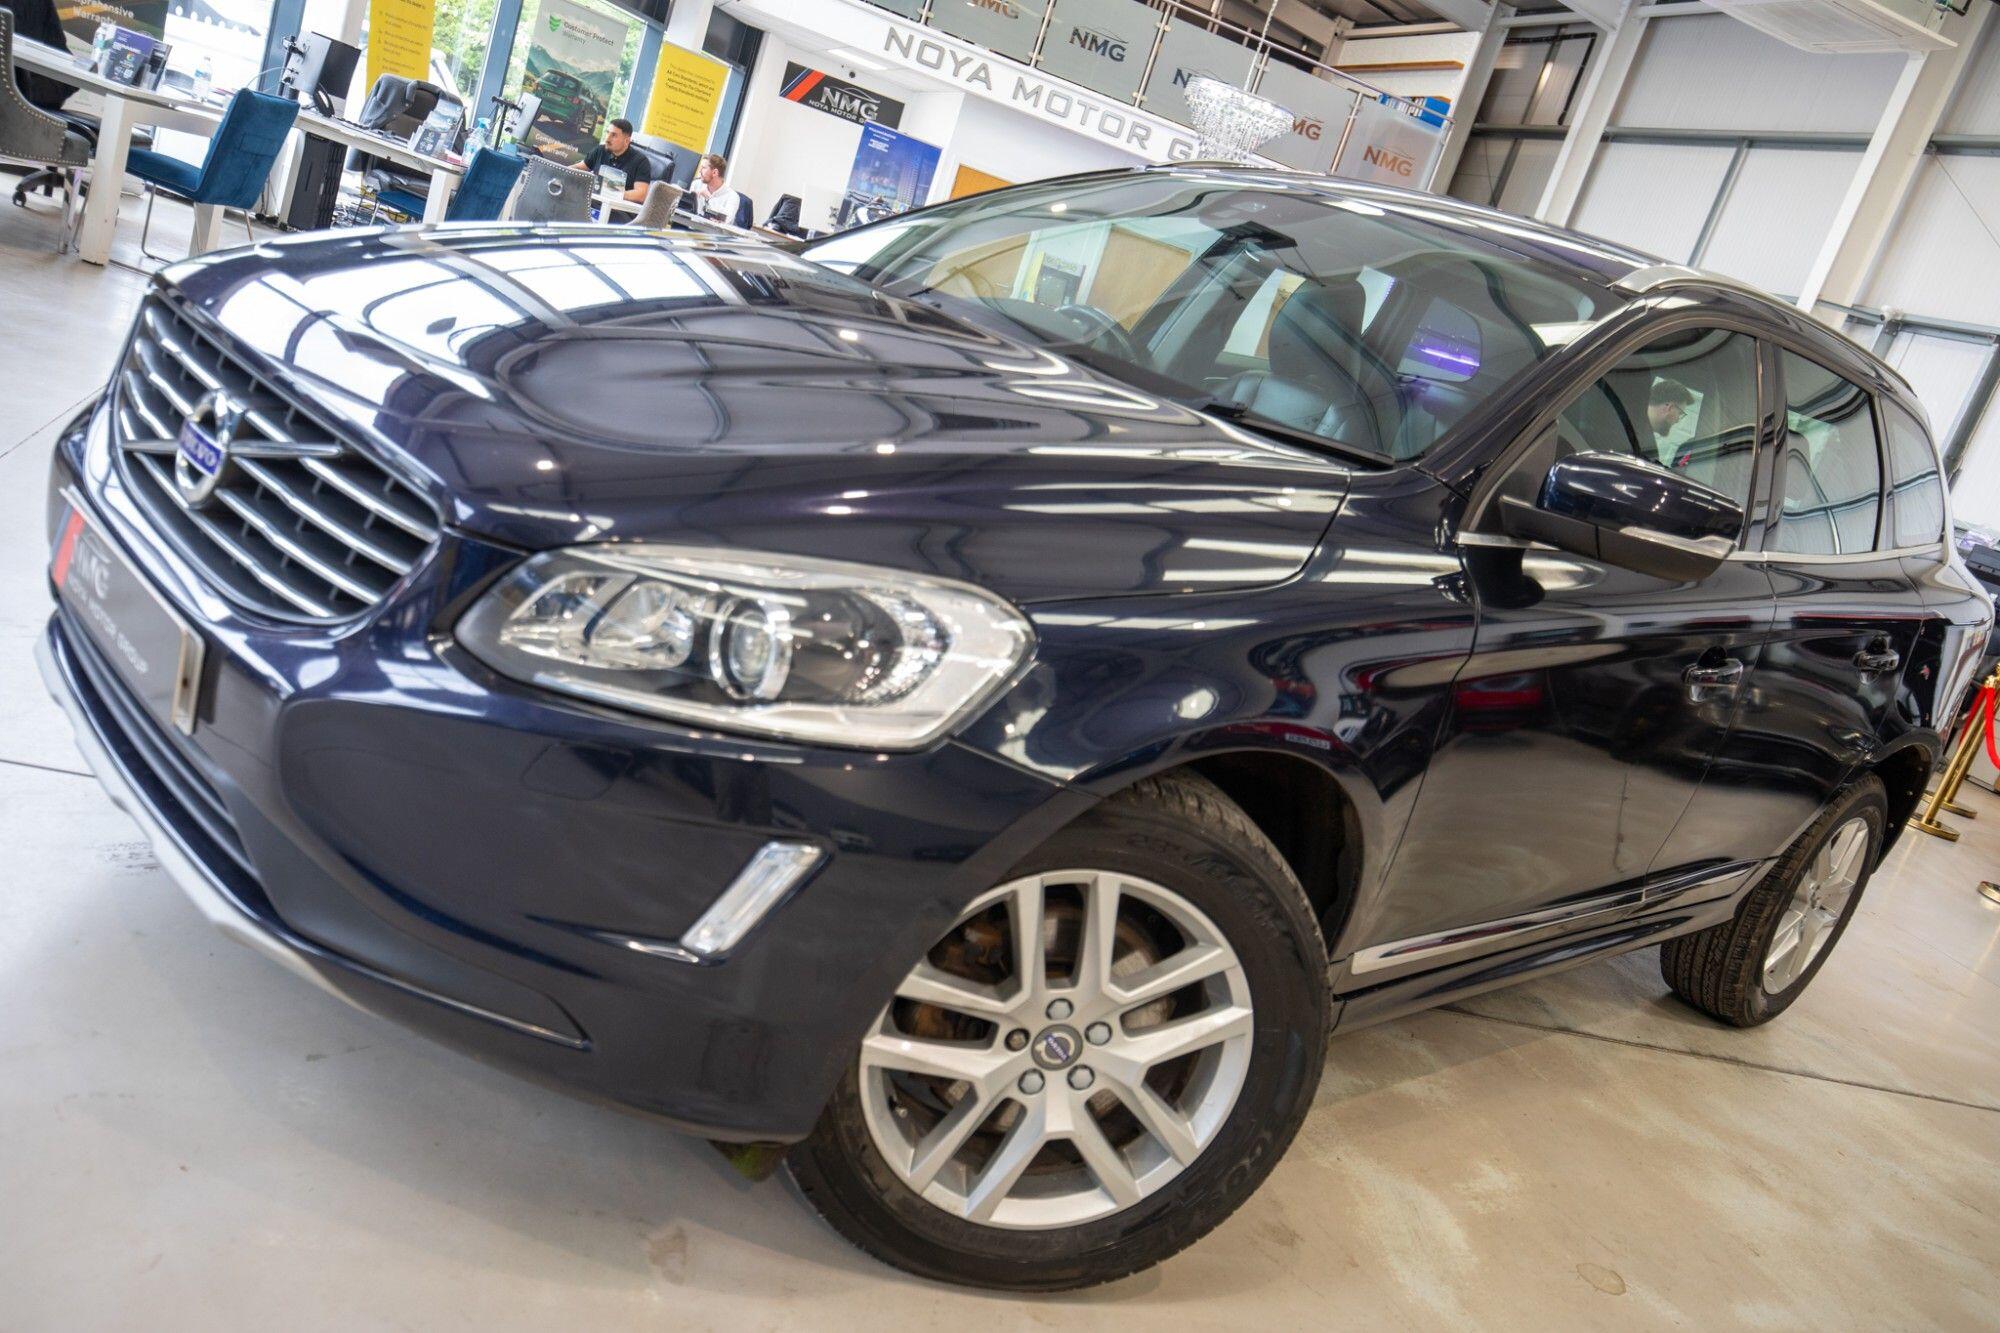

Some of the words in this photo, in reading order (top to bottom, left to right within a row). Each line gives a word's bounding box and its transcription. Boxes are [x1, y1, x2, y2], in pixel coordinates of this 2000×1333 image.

[969, 0, 1018, 19] MG
[564, 21, 592, 37] Customer
[593, 33, 614, 46] Protect
[1069, 26, 1127, 62] NMG
[884, 26, 992, 91] NOYA
[1012, 76, 1152, 151] MOTOR
[808, 100, 829, 111] NOYA
[830, 107, 858, 121] MOTOR
[820, 86, 879, 120] NMG
[1292, 118, 1322, 141] MG
[1363, 145, 1413, 177] NMG
